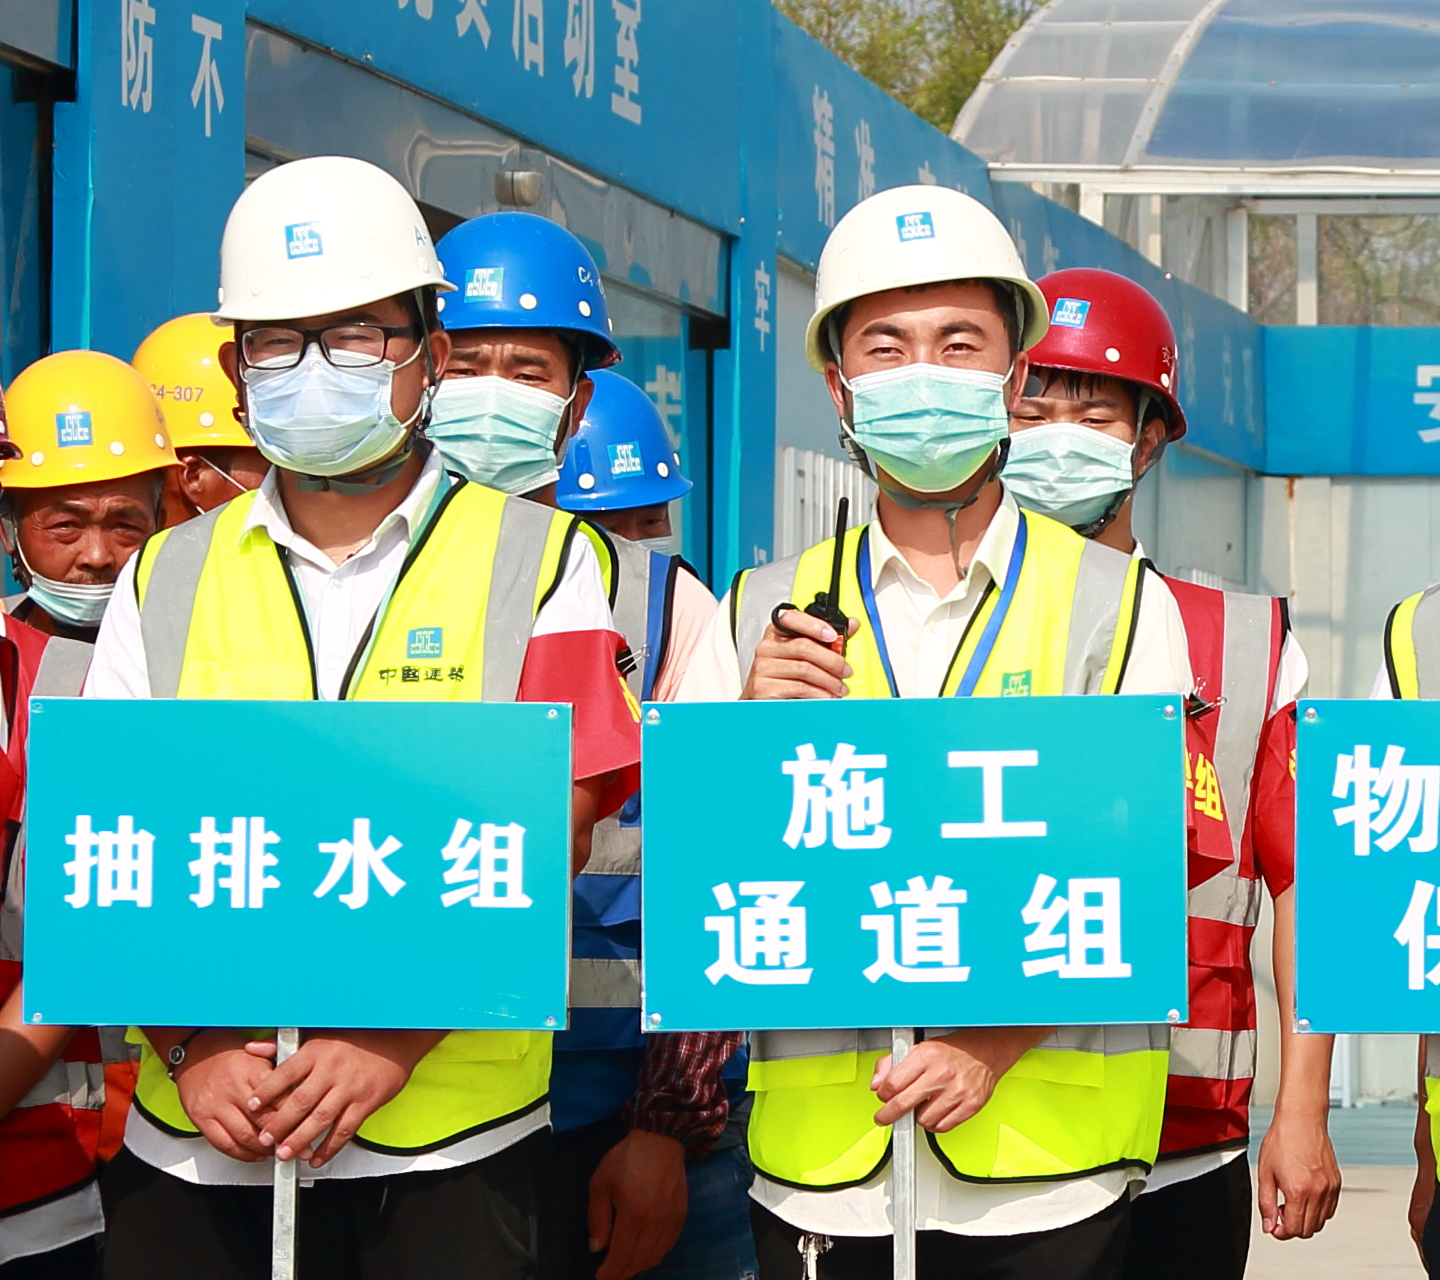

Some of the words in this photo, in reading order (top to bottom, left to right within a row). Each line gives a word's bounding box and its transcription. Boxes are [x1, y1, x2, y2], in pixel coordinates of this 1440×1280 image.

[191, 16, 224, 138] 不
[782, 742, 1048, 850] 施工
[63, 814, 533, 911] 抽排水组
[704, 874, 1133, 986] 通道组
